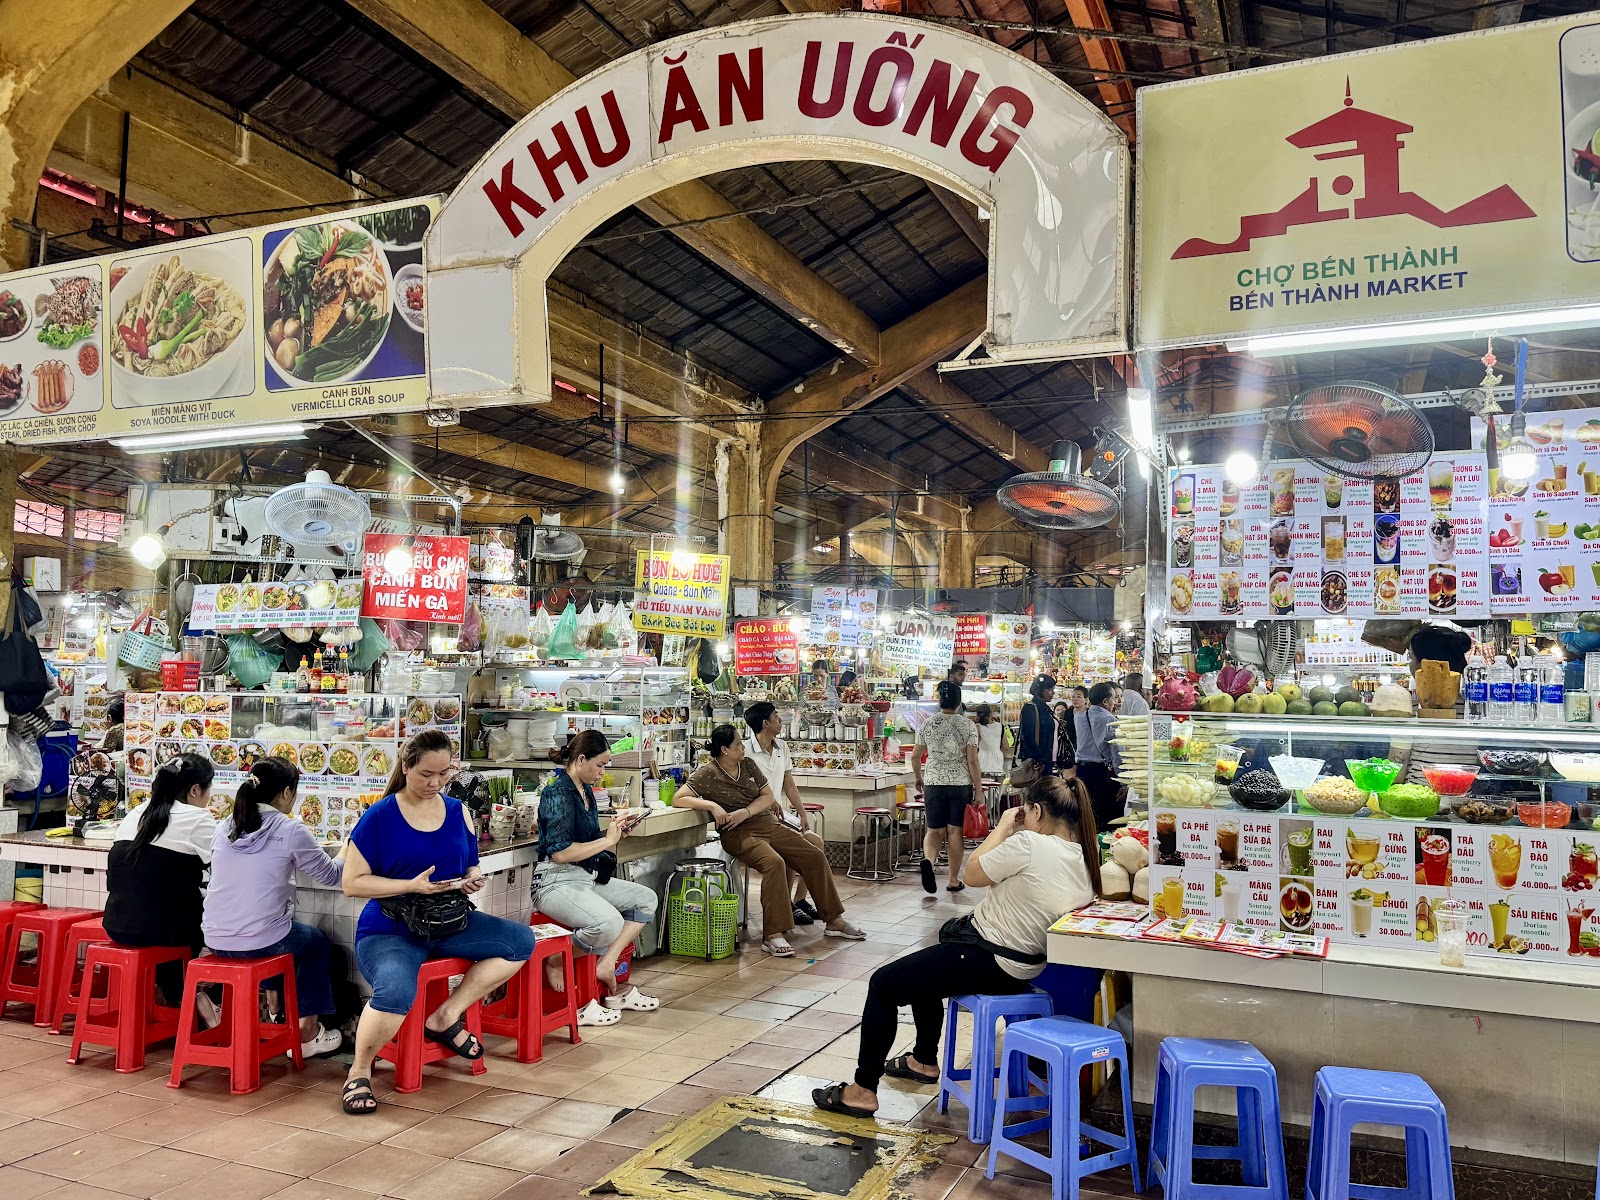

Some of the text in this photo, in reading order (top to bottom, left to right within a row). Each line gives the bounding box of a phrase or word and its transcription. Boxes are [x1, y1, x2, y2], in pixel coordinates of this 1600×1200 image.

[483, 31, 1034, 239] KHU ĂN UỐNG
[1237, 246, 1458, 287] CHỢ BẾN THÀNH
[1281, 283, 1359, 306] THÀNH
[1367, 272, 1468, 297] MARKET
[322, 385, 371, 399] CANH BÚN
[199, 402, 212, 413] VỊT
[291, 394, 405, 412] VERMICELLI CRAB SOUP
[130, 410, 235, 427] SOYA NOODLE WITH DUCK
[0, 424, 96, 440] STEAK, DRIED FISH, PORK CHOP
[643, 556, 669, 579] BÚN
[692, 559, 723, 582] HUẾ
[370, 572, 415, 587] CANH
[683, 584, 698, 598] Bún
[375, 588, 448, 610] MIẾN GÀ
[650, 599, 671, 612] TIẾU
[672, 605, 693, 615] NAM
[740, 623, 766, 634] CHÁO
[1194, 821, 1209, 831] PHÊ
[1256, 824, 1272, 833] PHÊ
[1190, 833, 1201, 842] ĐÁ
[1317, 828, 1333, 837] RAU
[1388, 832, 1404, 841] TRÀ
[1243, 834, 1272, 845] SỮA ĐÁ
[1318, 839, 1331, 849] MÁ
[1457, 834, 1474, 845] TRÀ
[1530, 839, 1548, 849] TRÀ
[1384, 843, 1407, 853] GỪNG
[1457, 847, 1474, 857] DÂU
[1384, 854, 1406, 862] Ginger
[1530, 851, 1548, 861] ĐÀO
[1450, 858, 1481, 866] Strawberry
[1187, 881, 1205, 891] XOÀI
[1186, 892, 1206, 900] Mango
[1316, 887, 1338, 898] BÁNH
[1248, 902, 1272, 910] Soursop
[1317, 900, 1337, 910] FLAN
[1382, 898, 1408, 909] CHUỐI
[1468, 900, 1484, 910] MÍA
[1531, 910, 1558, 921] RIÊNG
[1521, 929, 1550, 937] smoothie
